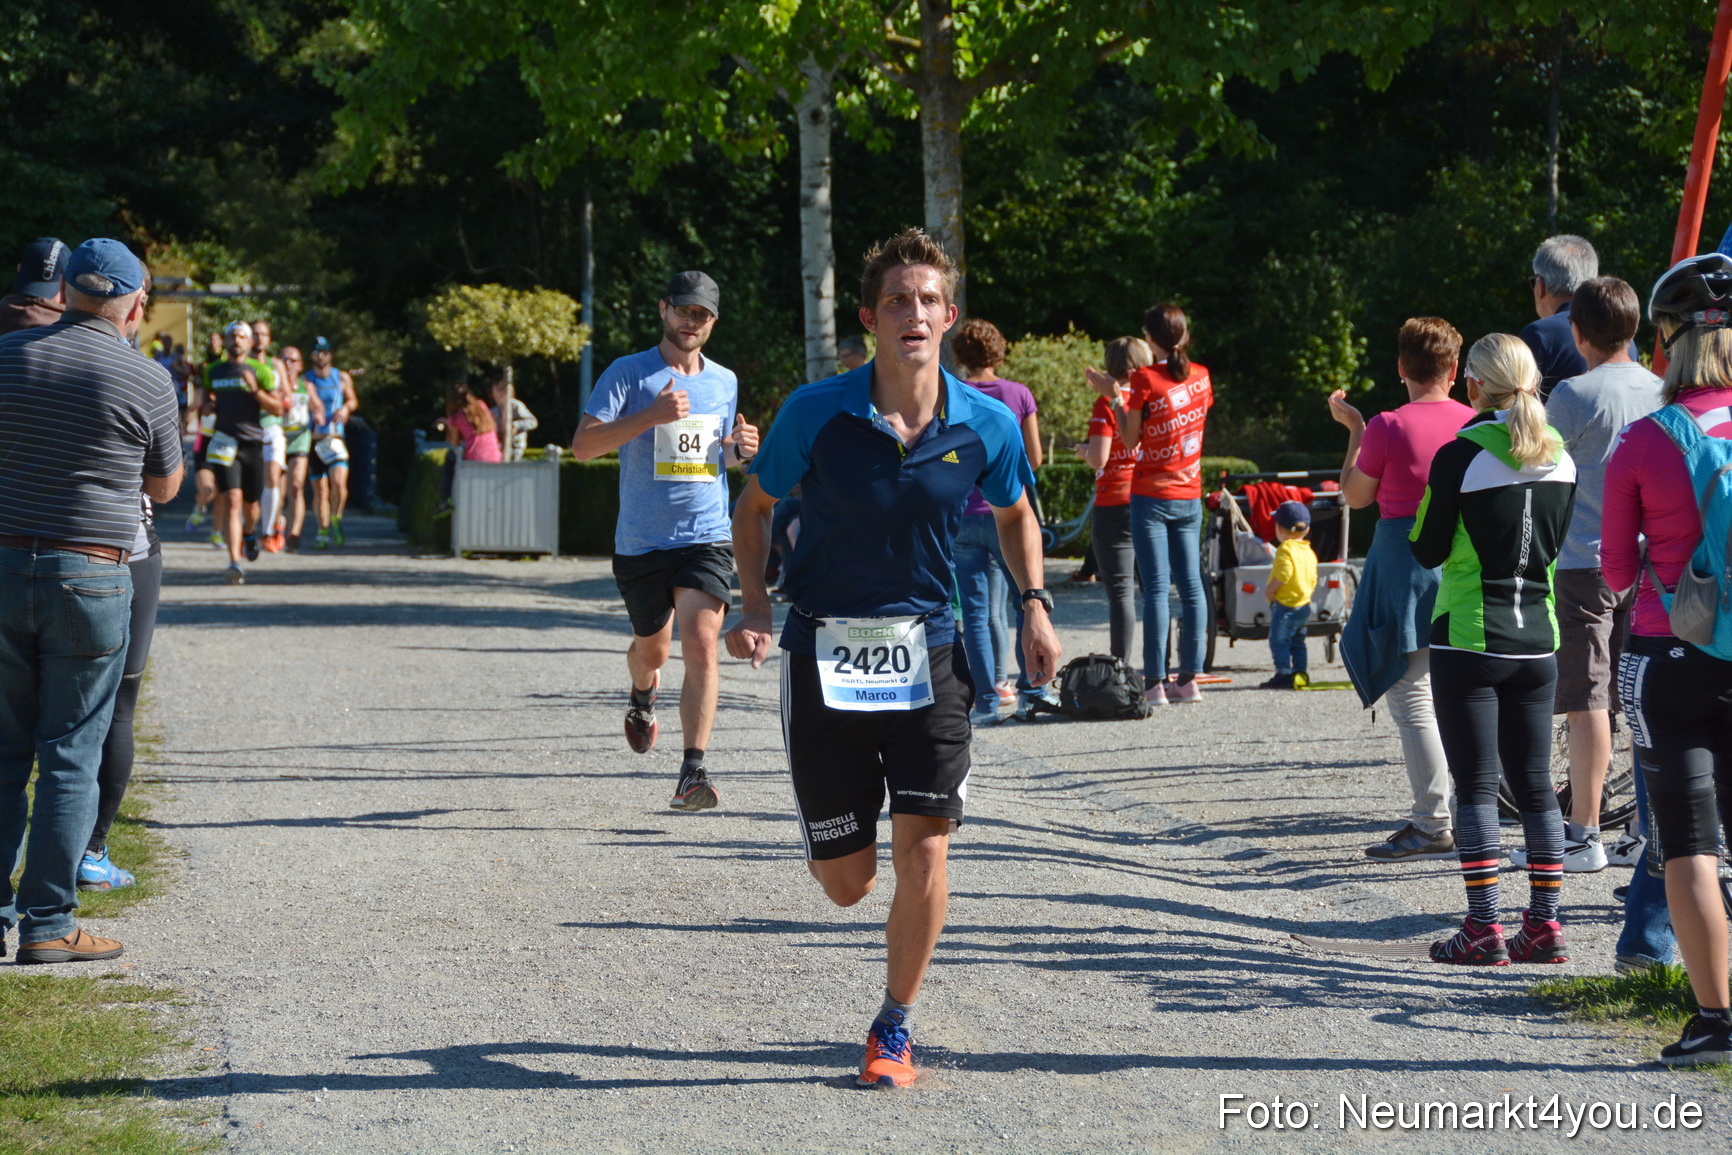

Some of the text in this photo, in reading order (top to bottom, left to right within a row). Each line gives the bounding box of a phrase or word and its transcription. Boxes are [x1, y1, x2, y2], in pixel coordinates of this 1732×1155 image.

[678, 433, 701, 453] 84
[671, 464, 707, 474] Christian
[848, 627, 895, 638] BOCK
[833, 645, 911, 675] 2420
[855, 690, 897, 701] Marco
[809, 812, 856, 830] TANKSTELLE
[811, 821, 860, 842] STIEGLER
